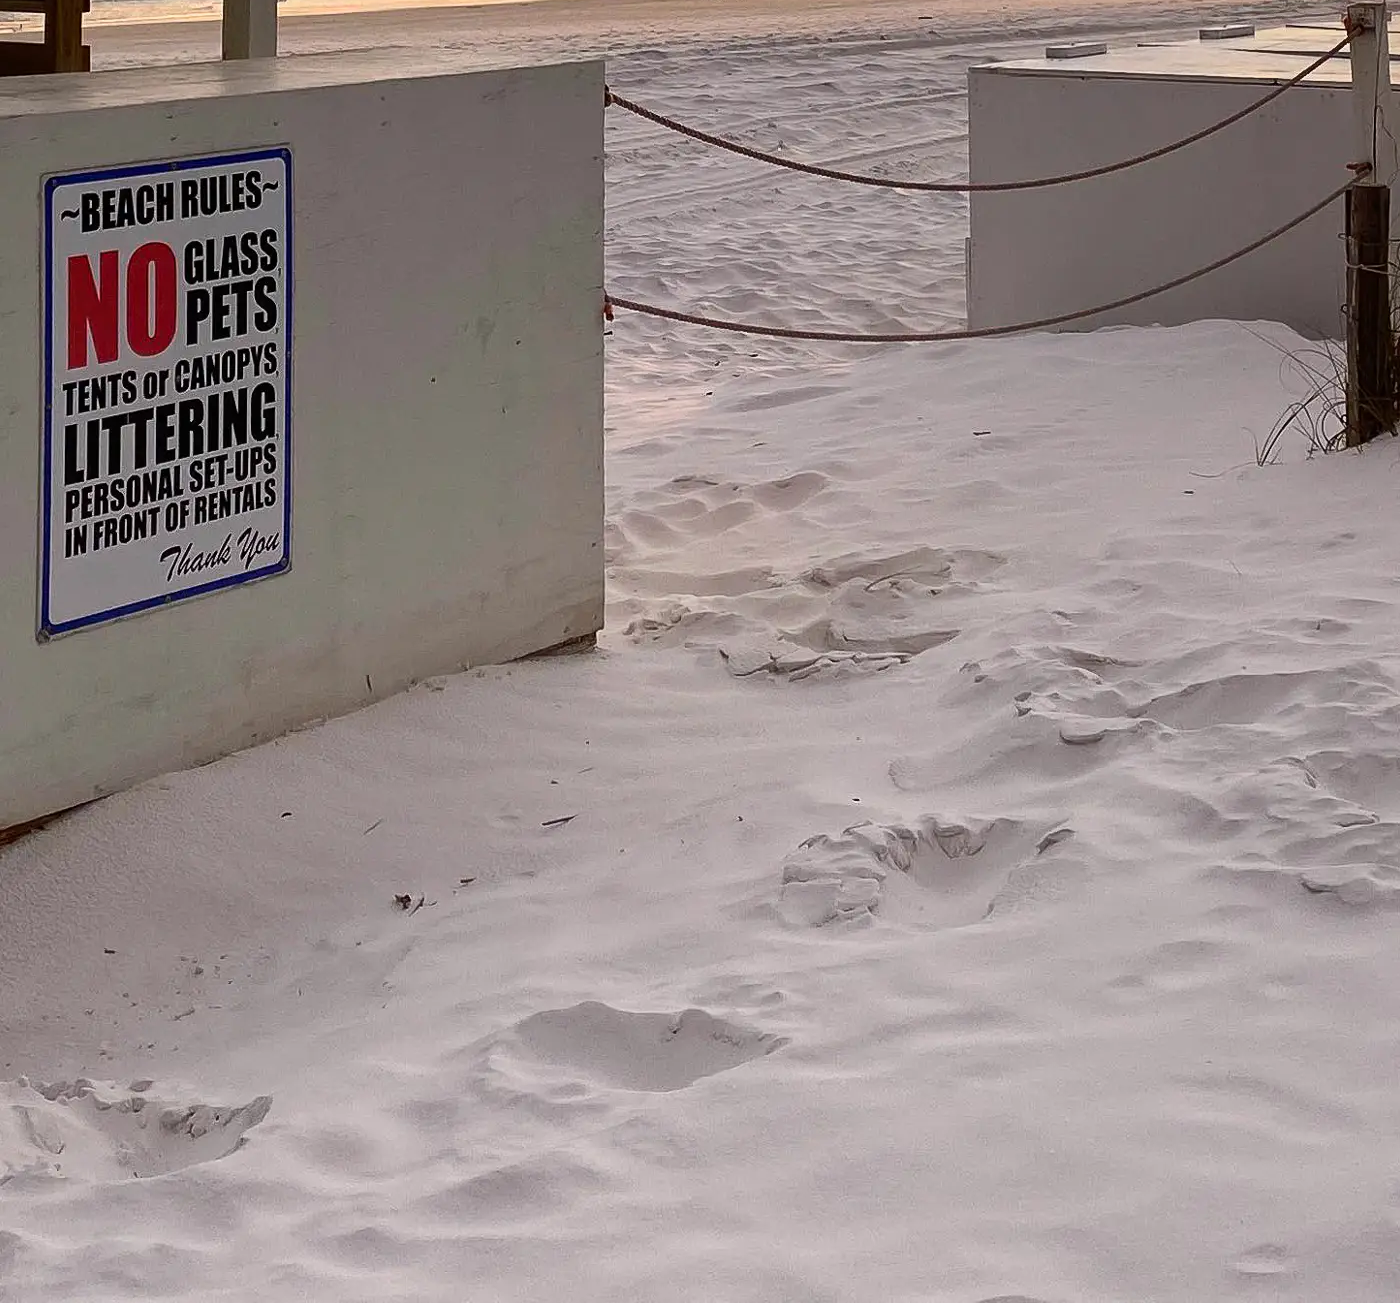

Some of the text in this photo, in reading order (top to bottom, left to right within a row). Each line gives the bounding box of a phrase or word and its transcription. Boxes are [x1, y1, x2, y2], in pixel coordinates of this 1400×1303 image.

[67, 241, 178, 371] NO
[63, 341, 280, 417] TENTS or CANOPYS,
[64, 442, 277, 524] PERSONAL SET-UPS
[64, 477, 277, 559] IN FRONT OF RENTALS
[159, 526, 280, 583] Thank You
